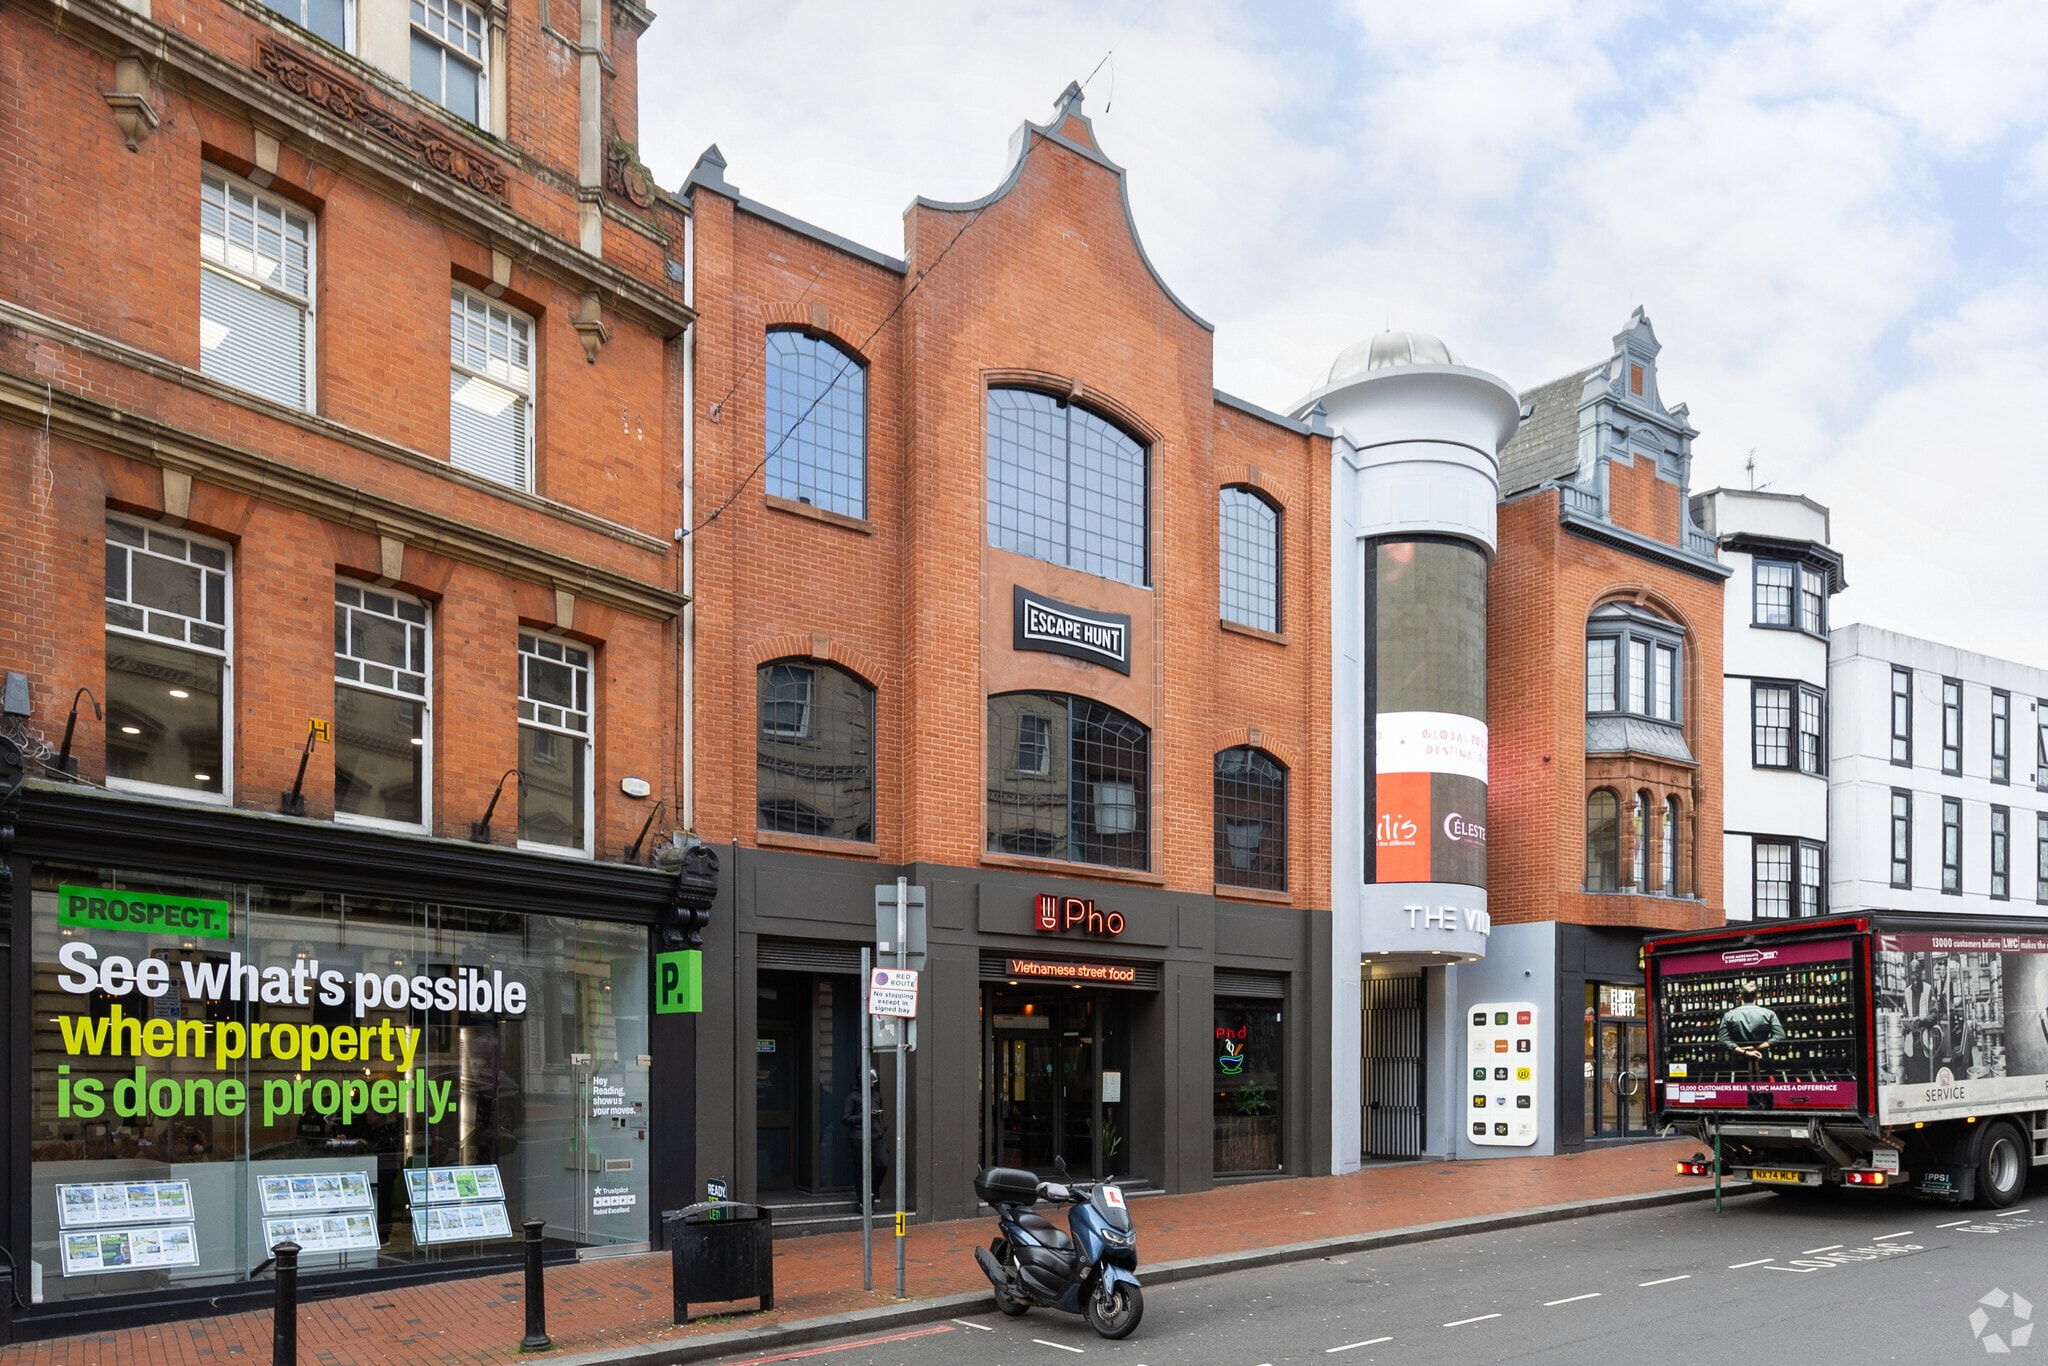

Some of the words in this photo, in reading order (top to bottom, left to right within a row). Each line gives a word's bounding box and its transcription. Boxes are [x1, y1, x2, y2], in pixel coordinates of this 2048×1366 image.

[1030, 608, 1081, 639] ESCAPE
[1084, 625, 1120, 651] HUNT
[69, 896, 221, 930] PROSPECT.
[1065, 898, 1125, 934] Pho
[1403, 905, 1457, 930] THE
[1932, 937, 1952, 948] 13000
[1953, 939, 1981, 949] customers
[1982, 938, 2000, 949] believe
[2002, 938, 2019, 949] LWC
[2020, 939, 2036, 949] makes
[1012, 959, 1075, 976] Vietnamese
[1077, 965, 1106, 978] street
[1109, 967, 1134, 980] food
[58, 942, 170, 997] See
[181, 952, 346, 1006] what's
[355, 968, 527, 1018] possible
[662, 962, 683, 1005] P.
[890, 980, 915, 988] ROUTE
[885, 992, 914, 1000] stopping
[58, 1004, 205, 1057] when
[216, 1018, 421, 1073] property
[593, 1076, 608, 1087] Hey
[1797, 1084, 1838, 1092] DIFFERENCE
[58, 1065, 105, 1118] is
[113, 1066, 246, 1118] done
[264, 1069, 457, 1127] properly.
[593, 1086, 626, 1097] Reading,
[1926, 1087, 1965, 1102] SERVICE
[593, 1096, 613, 1105] show
[614, 1097, 623, 1105] us
[593, 1107, 610, 1117] your
[610, 1106, 636, 1115] moves.
[1109, 1191, 1121, 1203] L
[608, 1206, 630, 1214] Excellent
